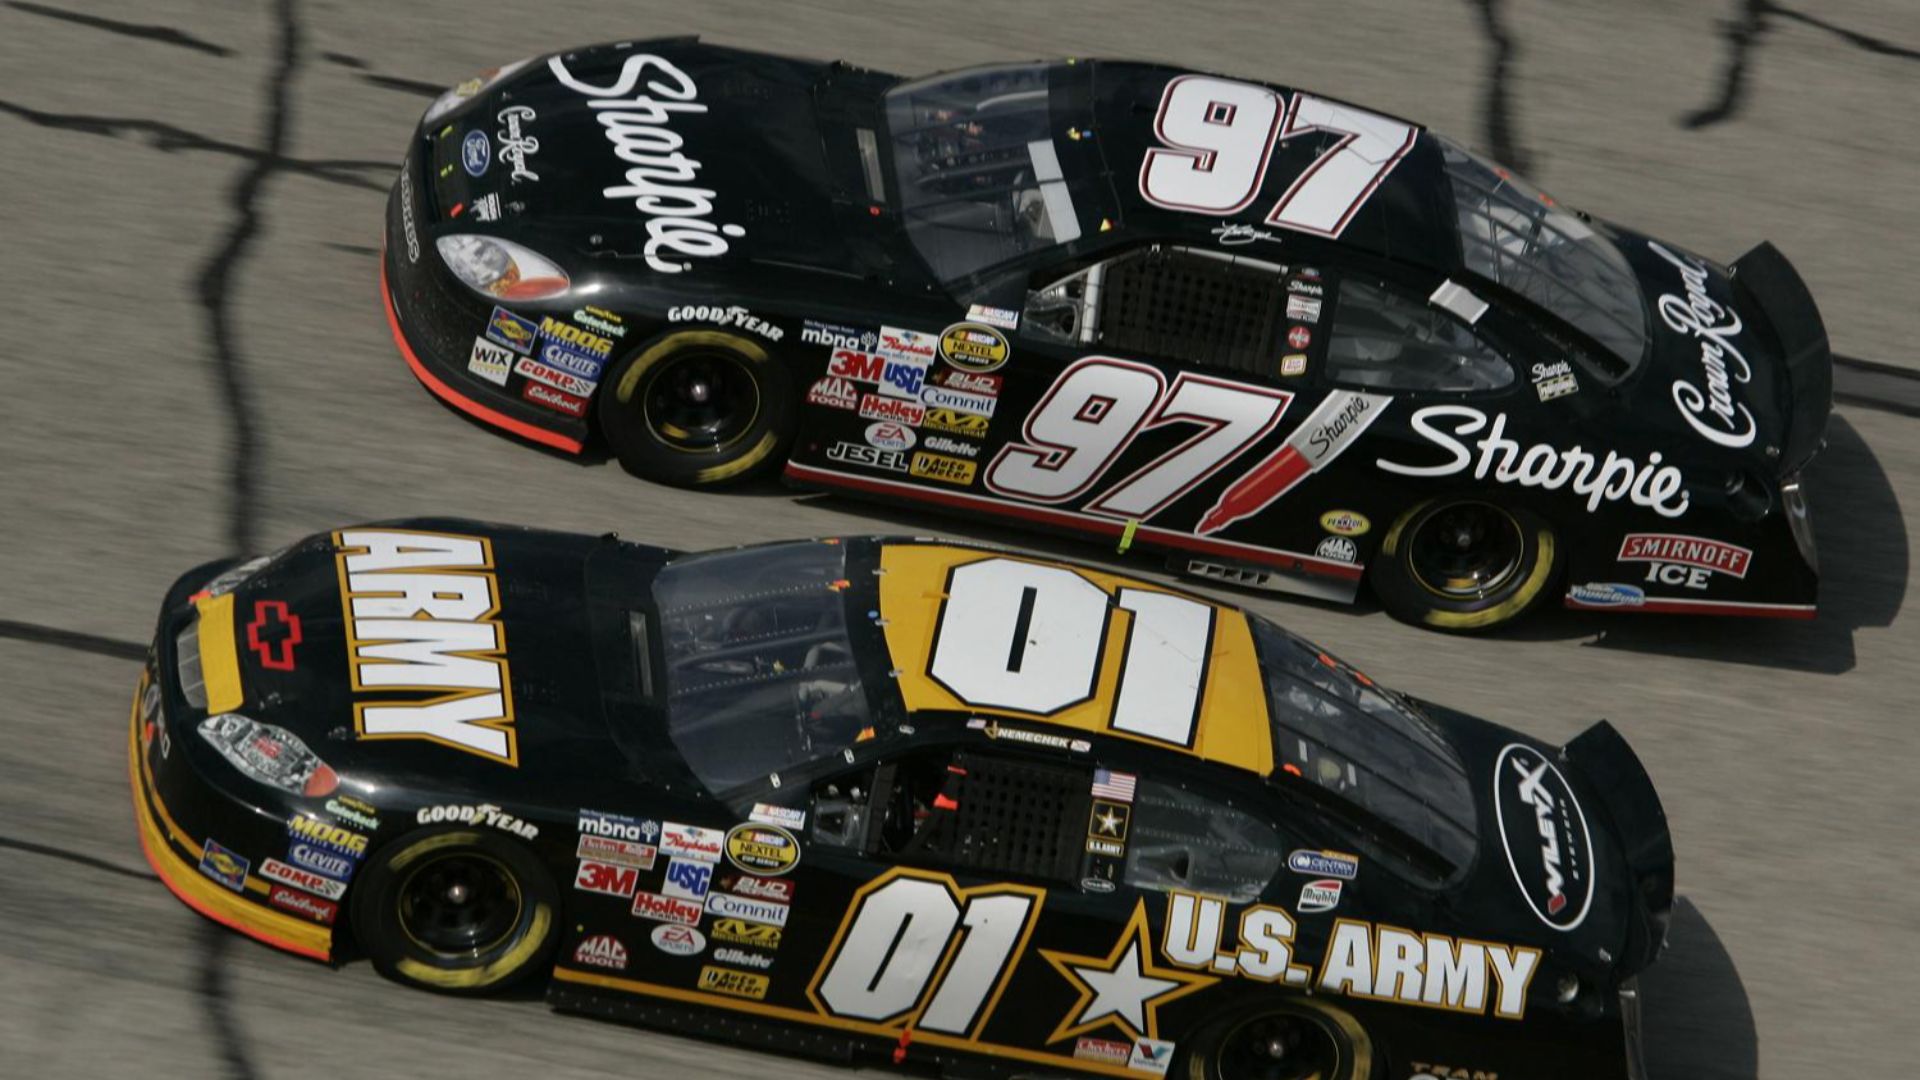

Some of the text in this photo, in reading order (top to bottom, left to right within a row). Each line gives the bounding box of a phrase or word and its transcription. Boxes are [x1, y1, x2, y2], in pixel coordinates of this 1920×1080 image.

[548, 53, 746, 274] Sharpie
[1139, 74, 1419, 239] 97
[540, 315, 614, 353] MOOG
[668, 305, 784, 342] GOODYEAR
[801, 327, 860, 350] mbna
[475, 346, 508, 367] WIX
[545, 344, 598, 375] CLEVITE
[952, 340, 993, 356] NEXTEL
[1648, 241, 1756, 448] Crown Royal
[520, 359, 576, 390] COMP
[831, 350, 886, 382] 3M
[884, 362, 924, 395] USG
[806, 393, 857, 410] TOOLS
[809, 376, 857, 402] MAC
[920, 387, 992, 411] Commit
[862, 395, 924, 426] Holley
[875, 423, 907, 442] EA
[983, 355, 1296, 524] 97
[1308, 395, 1371, 460] Sharpie
[826, 440, 910, 473] JESEL
[924, 435, 979, 457] Gillette
[1376, 404, 1690, 518] Sharpie
[1627, 538, 1743, 570] SMIRNOFF
[1645, 561, 1712, 590] ICE
[332, 527, 519, 768] ARMY
[925, 557, 1217, 751] 01
[998, 727, 1069, 750] NEMECHEK
[288, 815, 369, 854] MOOG
[416, 804, 539, 841] GOODYEAR
[578, 817, 641, 841] mbna
[293, 844, 350, 876] CLEVITE
[740, 841, 782, 858] NEXTEL
[265, 859, 324, 890] COMP
[578, 863, 638, 896] 3M
[667, 862, 711, 896] USG
[635, 893, 700, 924] Holley
[708, 894, 785, 922] Commit
[1302, 887, 1338, 904] Mighty
[577, 936, 627, 961] MAC
[662, 926, 695, 945] EA
[576, 952, 626, 970] TOOLS
[714, 947, 772, 969] Gillette
[806, 866, 1046, 1040] 01
[1161, 888, 1543, 1020] U.S. ARMY
